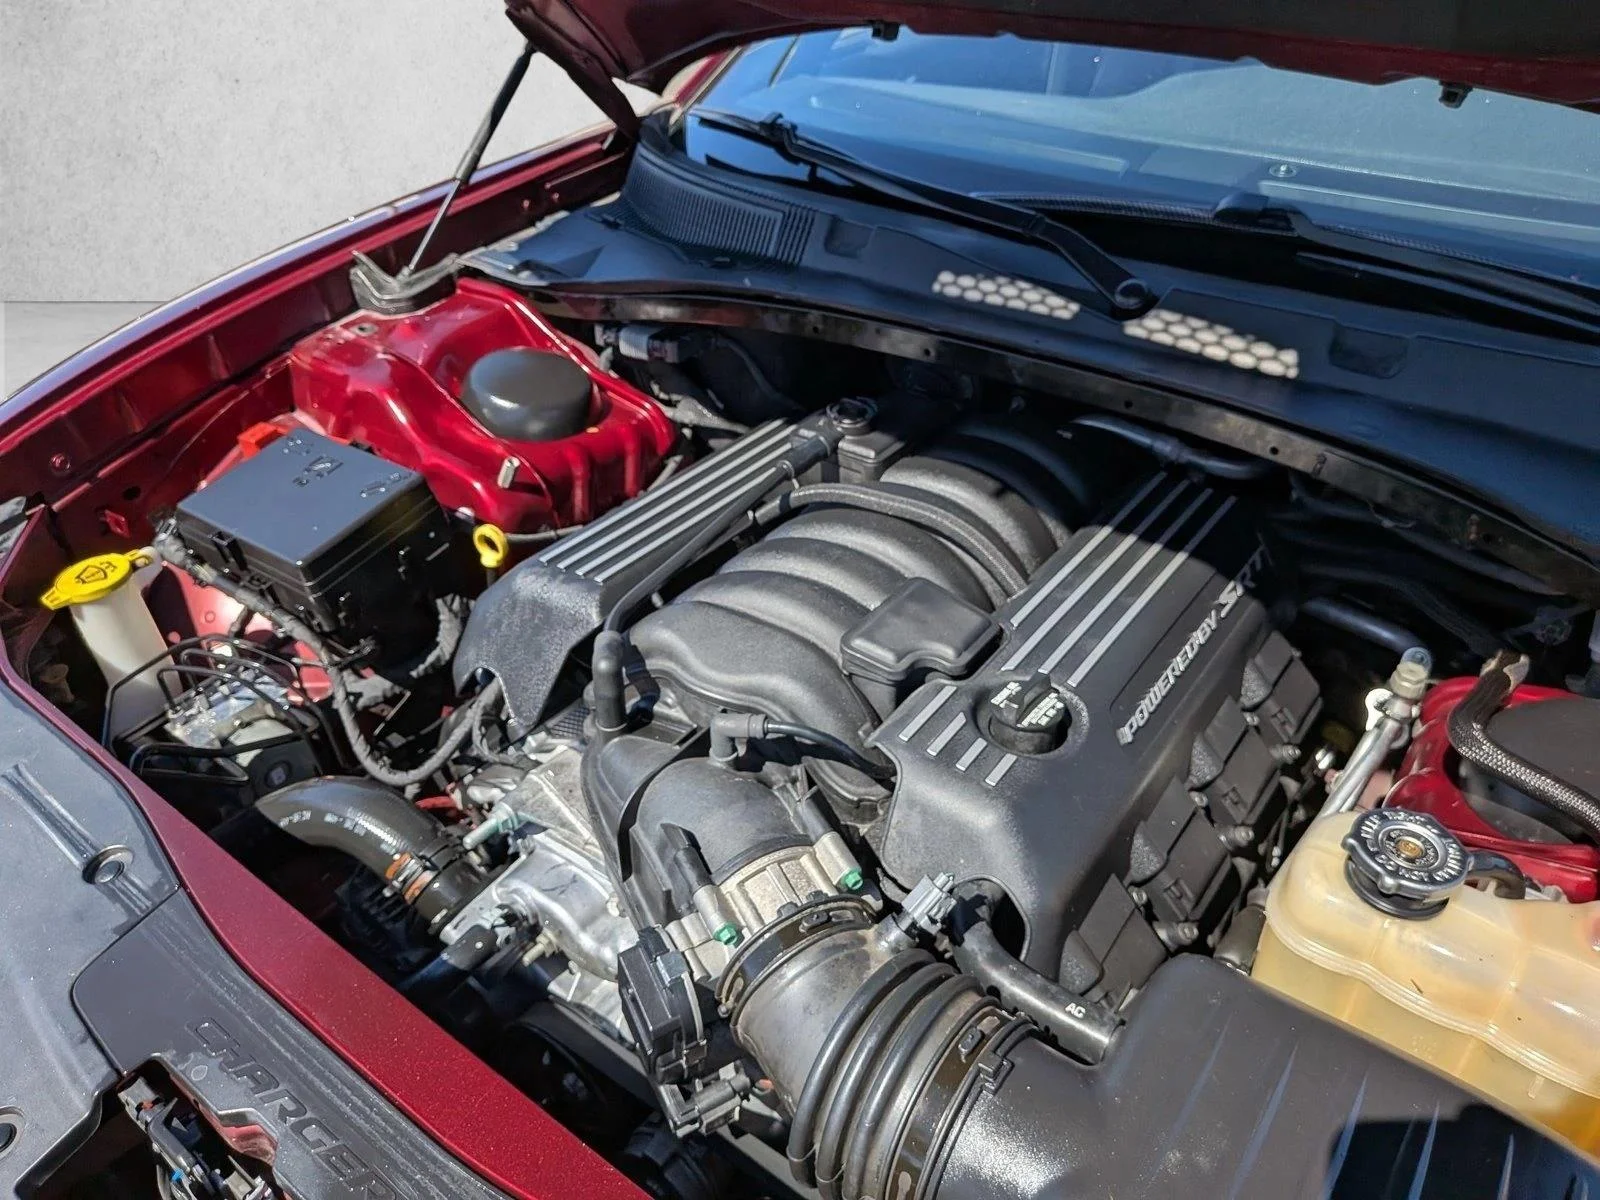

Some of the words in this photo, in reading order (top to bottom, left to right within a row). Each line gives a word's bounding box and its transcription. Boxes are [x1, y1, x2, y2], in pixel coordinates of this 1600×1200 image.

[1122, 632, 1200, 744] POWERED
[1196, 609, 1217, 645] BY
[1064, 1002, 1086, 1019] AC
[190, 1016, 399, 1200] CHARGER
